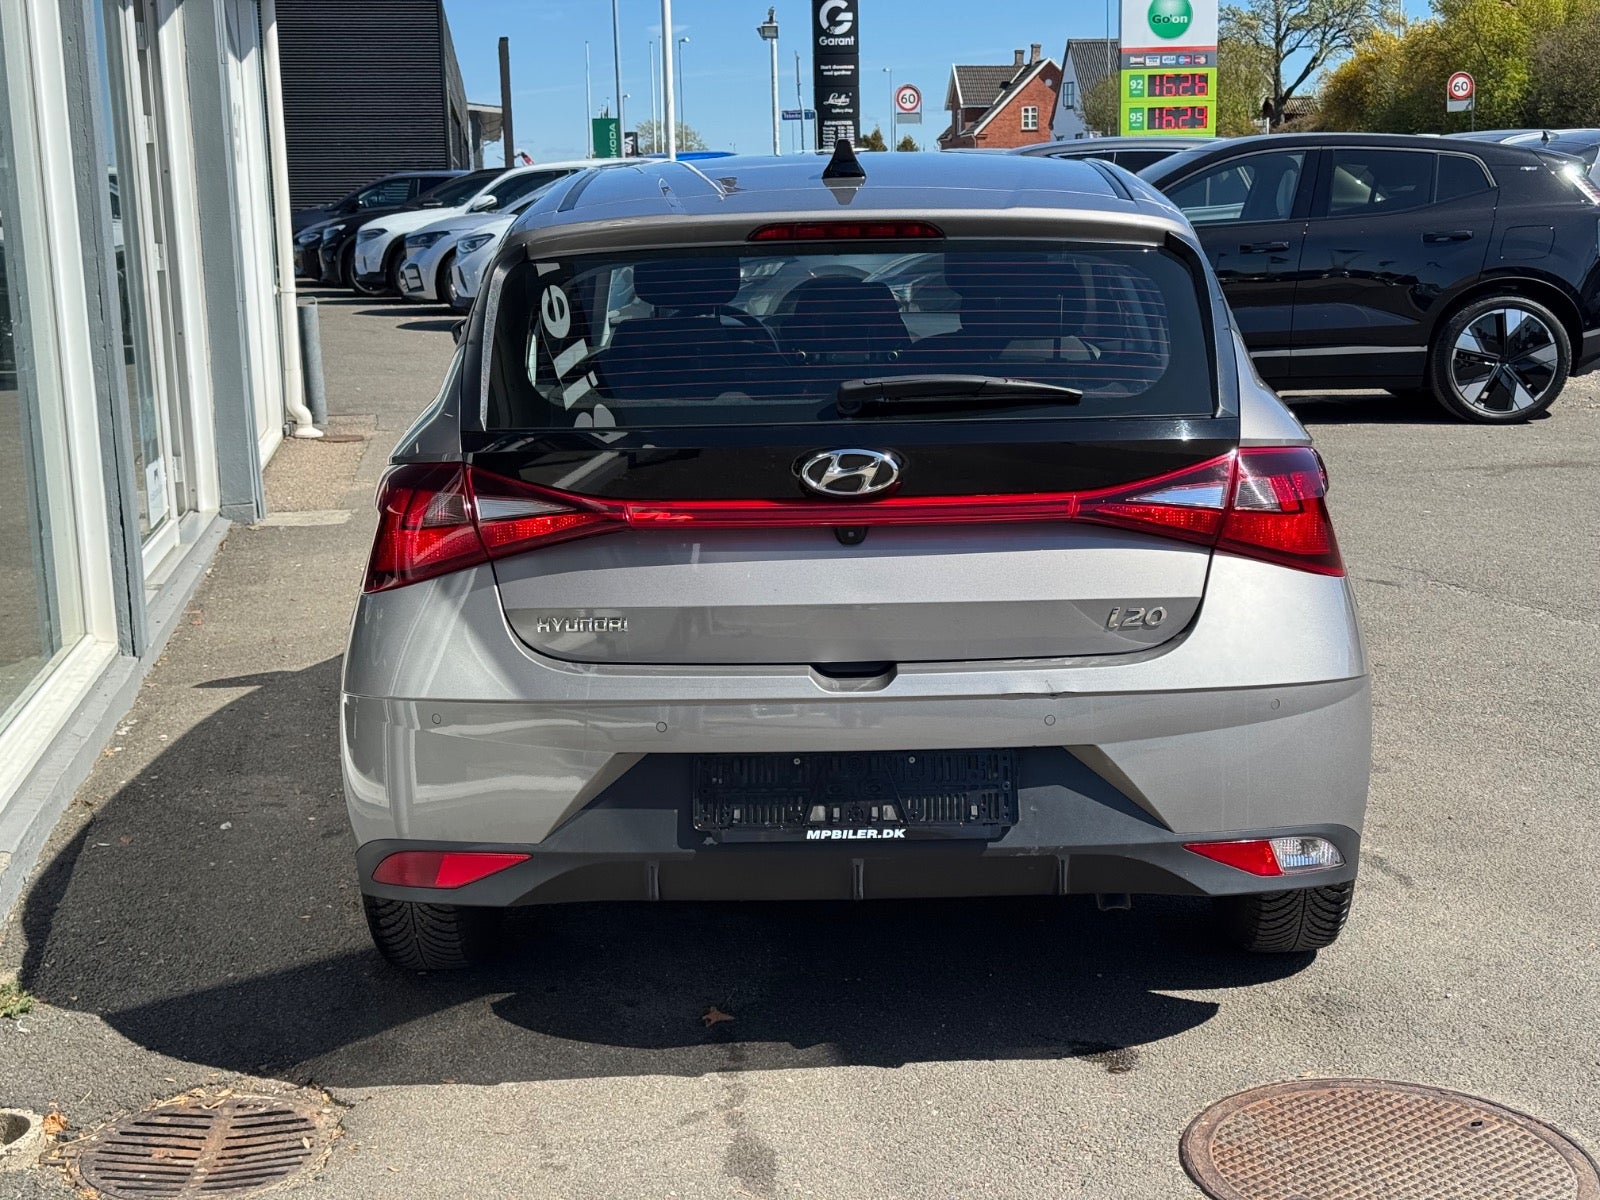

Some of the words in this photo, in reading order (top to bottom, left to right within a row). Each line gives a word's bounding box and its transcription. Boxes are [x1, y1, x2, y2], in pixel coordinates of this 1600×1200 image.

[1152, 14, 1188, 24] Go'on
[819, 36, 854, 46] Garant
[1130, 79, 1143, 89] 92
[1453, 81, 1469, 92] 60
[901, 93, 916, 105] 60
[1130, 112, 1142, 122] 95
[1107, 606, 1168, 629] i20
[536, 617, 629, 633] HYUNDAI
[806, 828, 906, 840] MPBILER.DK
